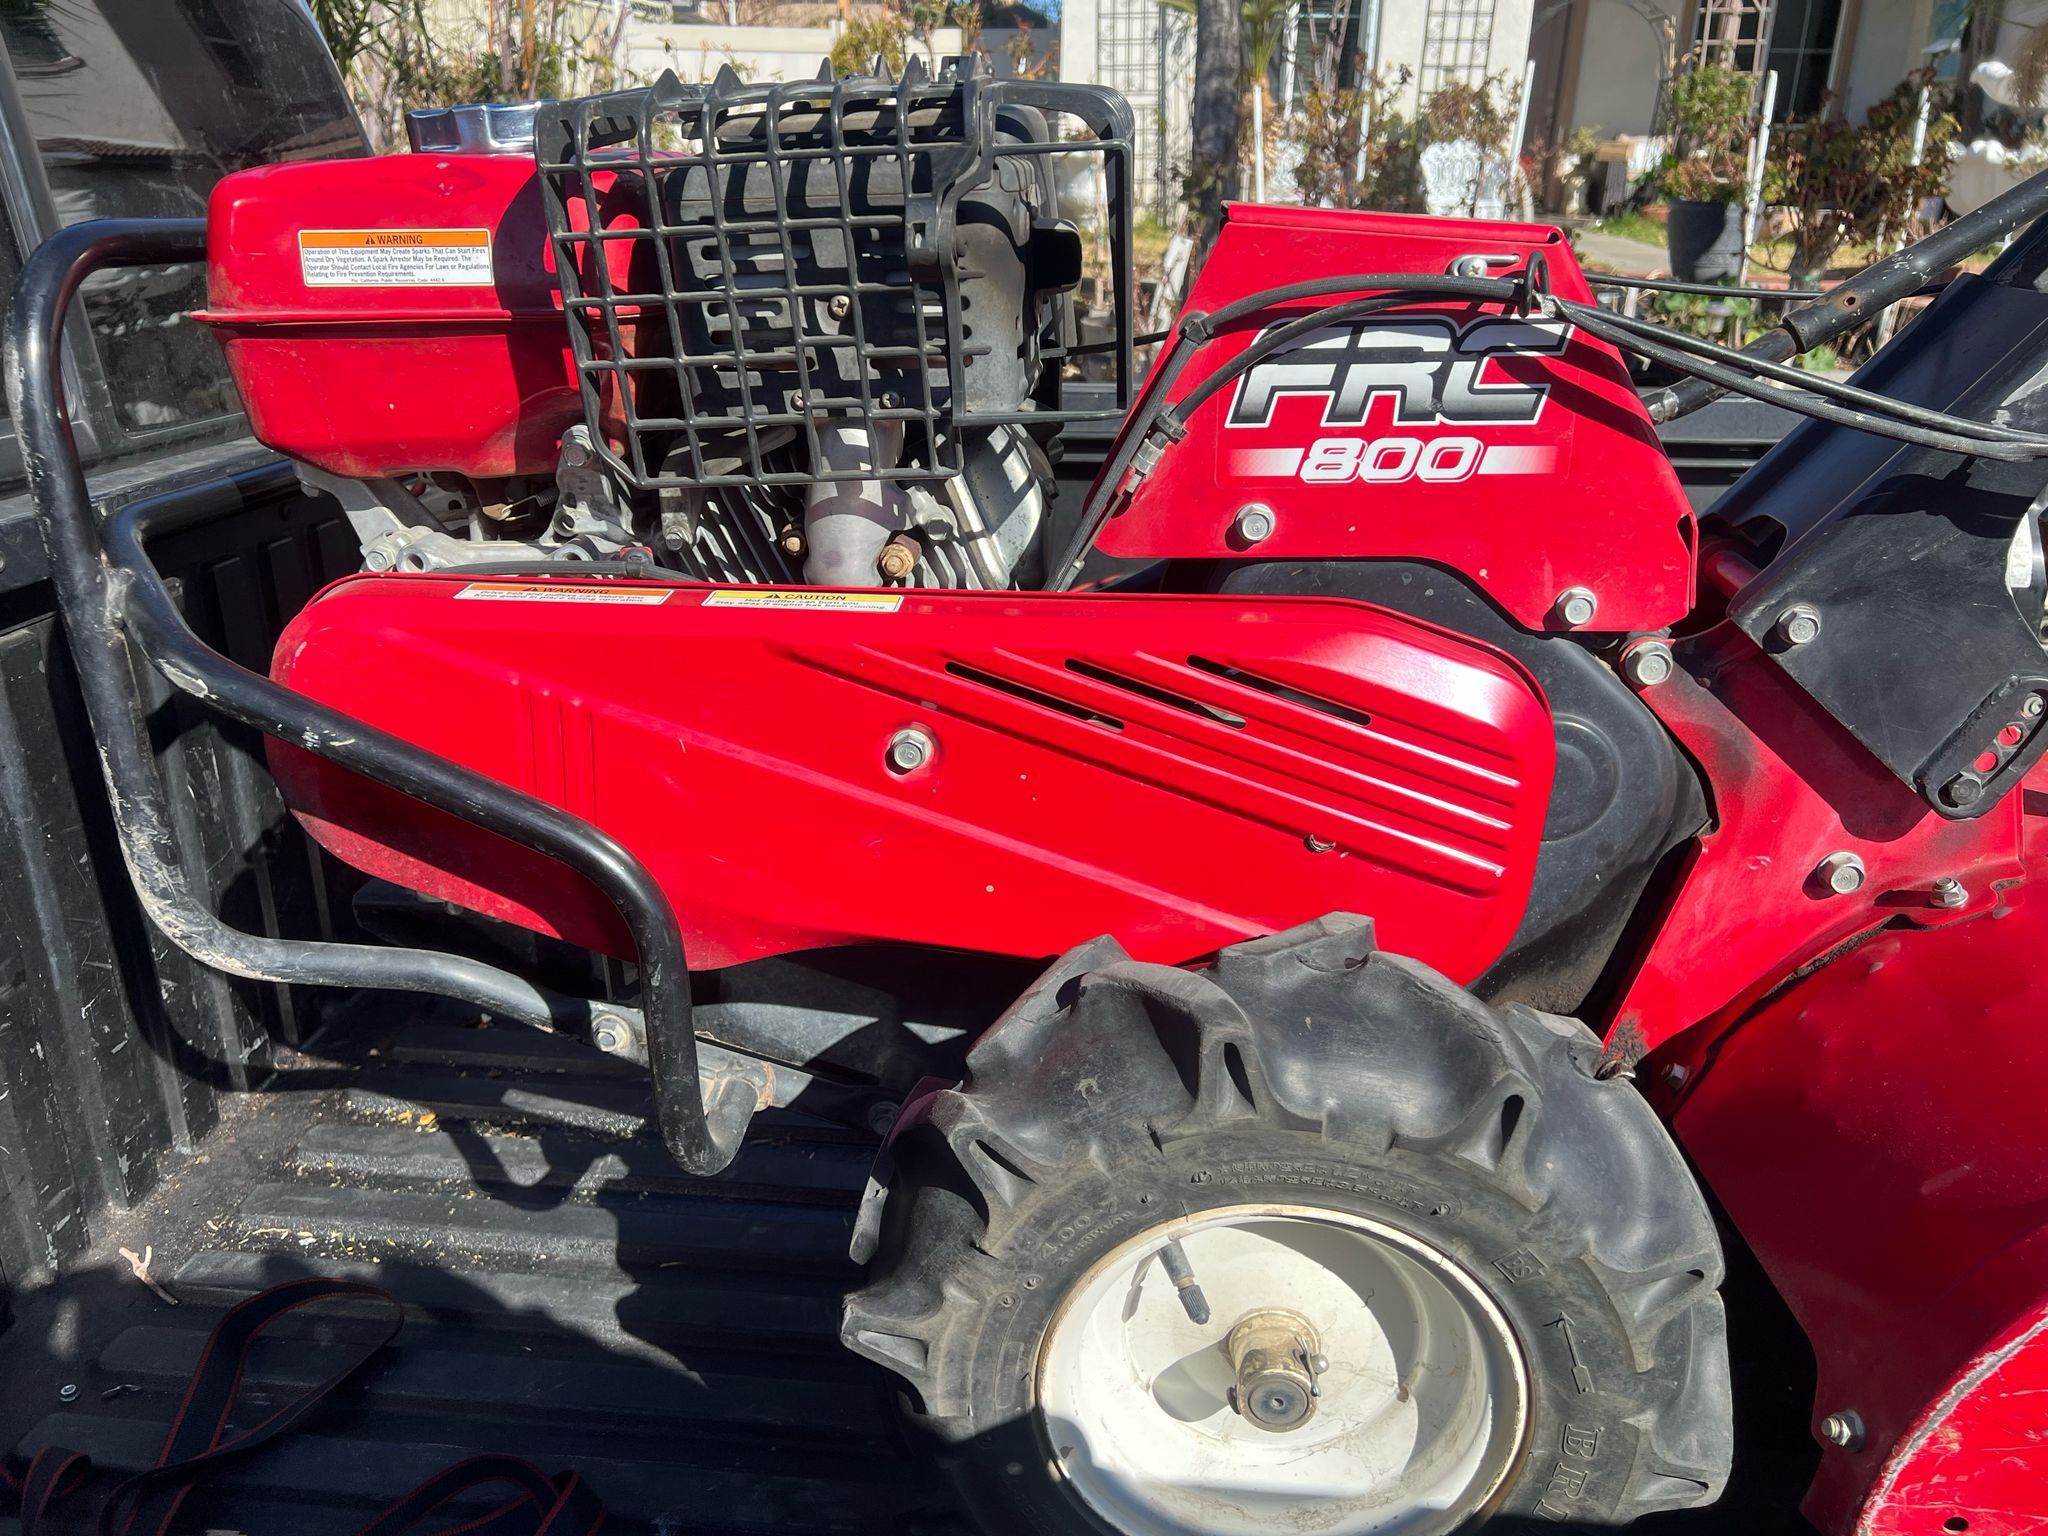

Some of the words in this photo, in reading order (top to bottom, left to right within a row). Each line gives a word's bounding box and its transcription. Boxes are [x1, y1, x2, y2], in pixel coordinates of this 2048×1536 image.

[377, 235, 423, 245] WARNING
[380, 248, 391, 256] May
[325, 256, 335, 264] Dry
[374, 256, 388, 264] Spark
[413, 255, 424, 263] May
[458, 263, 490, 271] Regulations
[1224, 314, 1575, 428] FRC
[1299, 436, 1484, 484] 800
